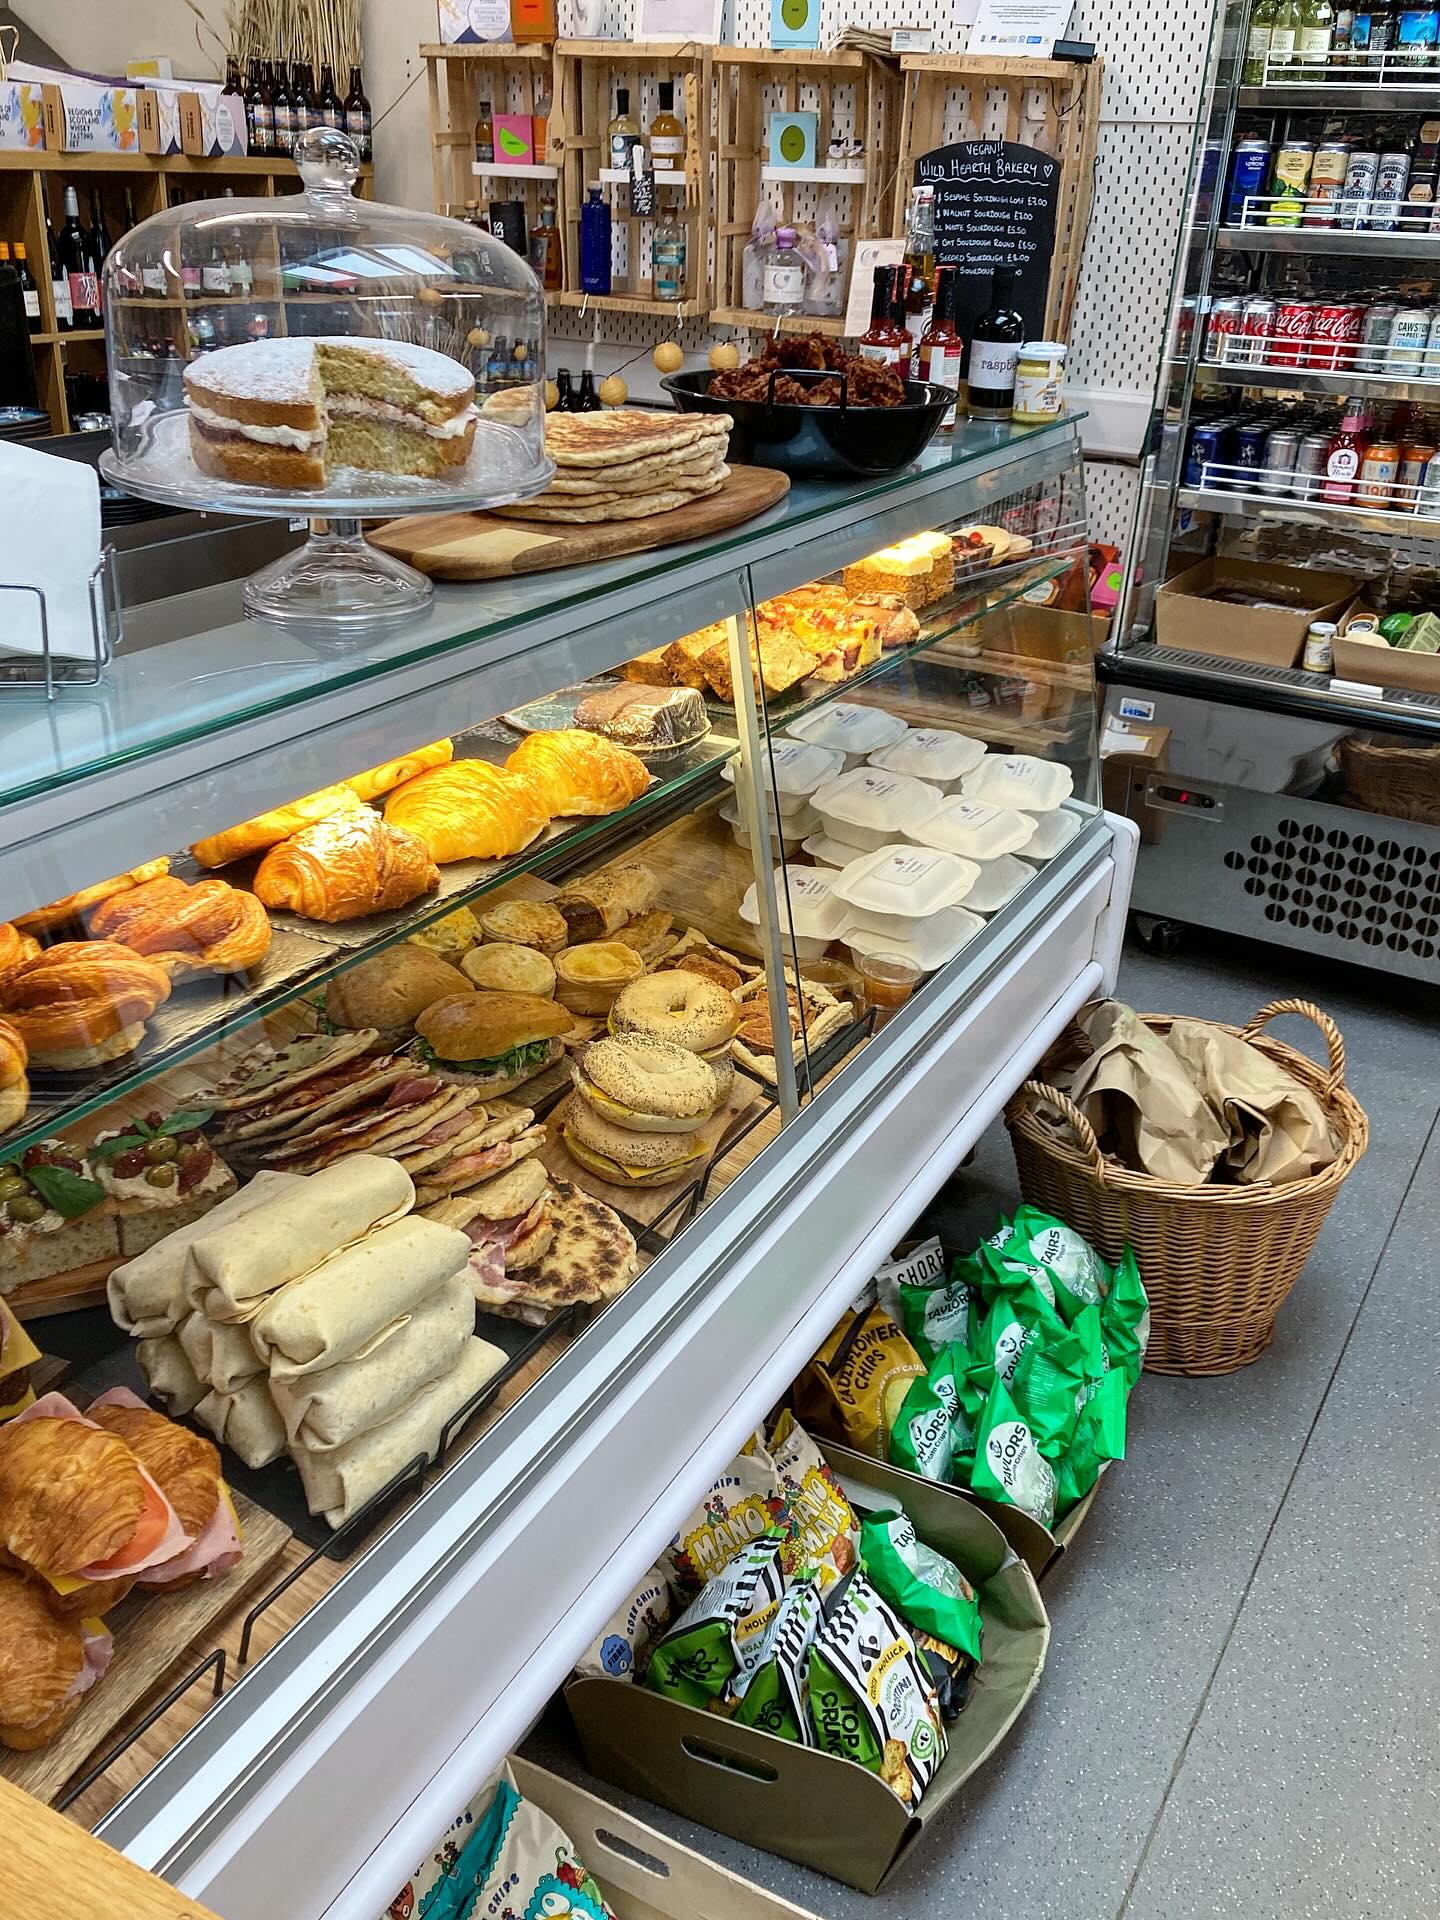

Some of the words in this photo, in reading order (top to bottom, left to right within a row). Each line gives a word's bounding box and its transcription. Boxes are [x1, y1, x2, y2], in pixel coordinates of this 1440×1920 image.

[67, 107, 93, 117] REGIONS
[69, 116, 100, 125] SCOTLAND
[69, 132, 94, 141] TASTING
[70, 124, 90, 133] WHISKY
[919, 159, 945, 177] WILD
[950, 158, 991, 177] HEARTH
[995, 158, 1038, 178] BAKERY
[943, 208, 971, 218] WALNUT
[973, 209, 1011, 220] SOURDOUGH
[966, 223, 1005, 233] SOURDOUGH
[956, 237, 992, 247] SOURDOUGH
[966, 252, 1004, 263] SOURDOUGH
[960, 266, 995, 276] SOURDOUG
[897, 1247, 945, 1287] SHORE
[854, 1349, 887, 1390] CHIPS
[775, 1454, 800, 1474] HIPS
[1003, 1424, 1027, 1486] TAYLORS
[801, 1498, 848, 1554] MASA
[692, 1506, 766, 1569] MANO
[626, 1605, 639, 1636] CORN
[635, 1586, 661, 1607] CHIPS
[607, 1644, 626, 1668] FIBRE
[821, 1691, 845, 1758] CRUNC
[840, 1701, 861, 1749] TOP
[487, 1872, 520, 1915] CHIPS
